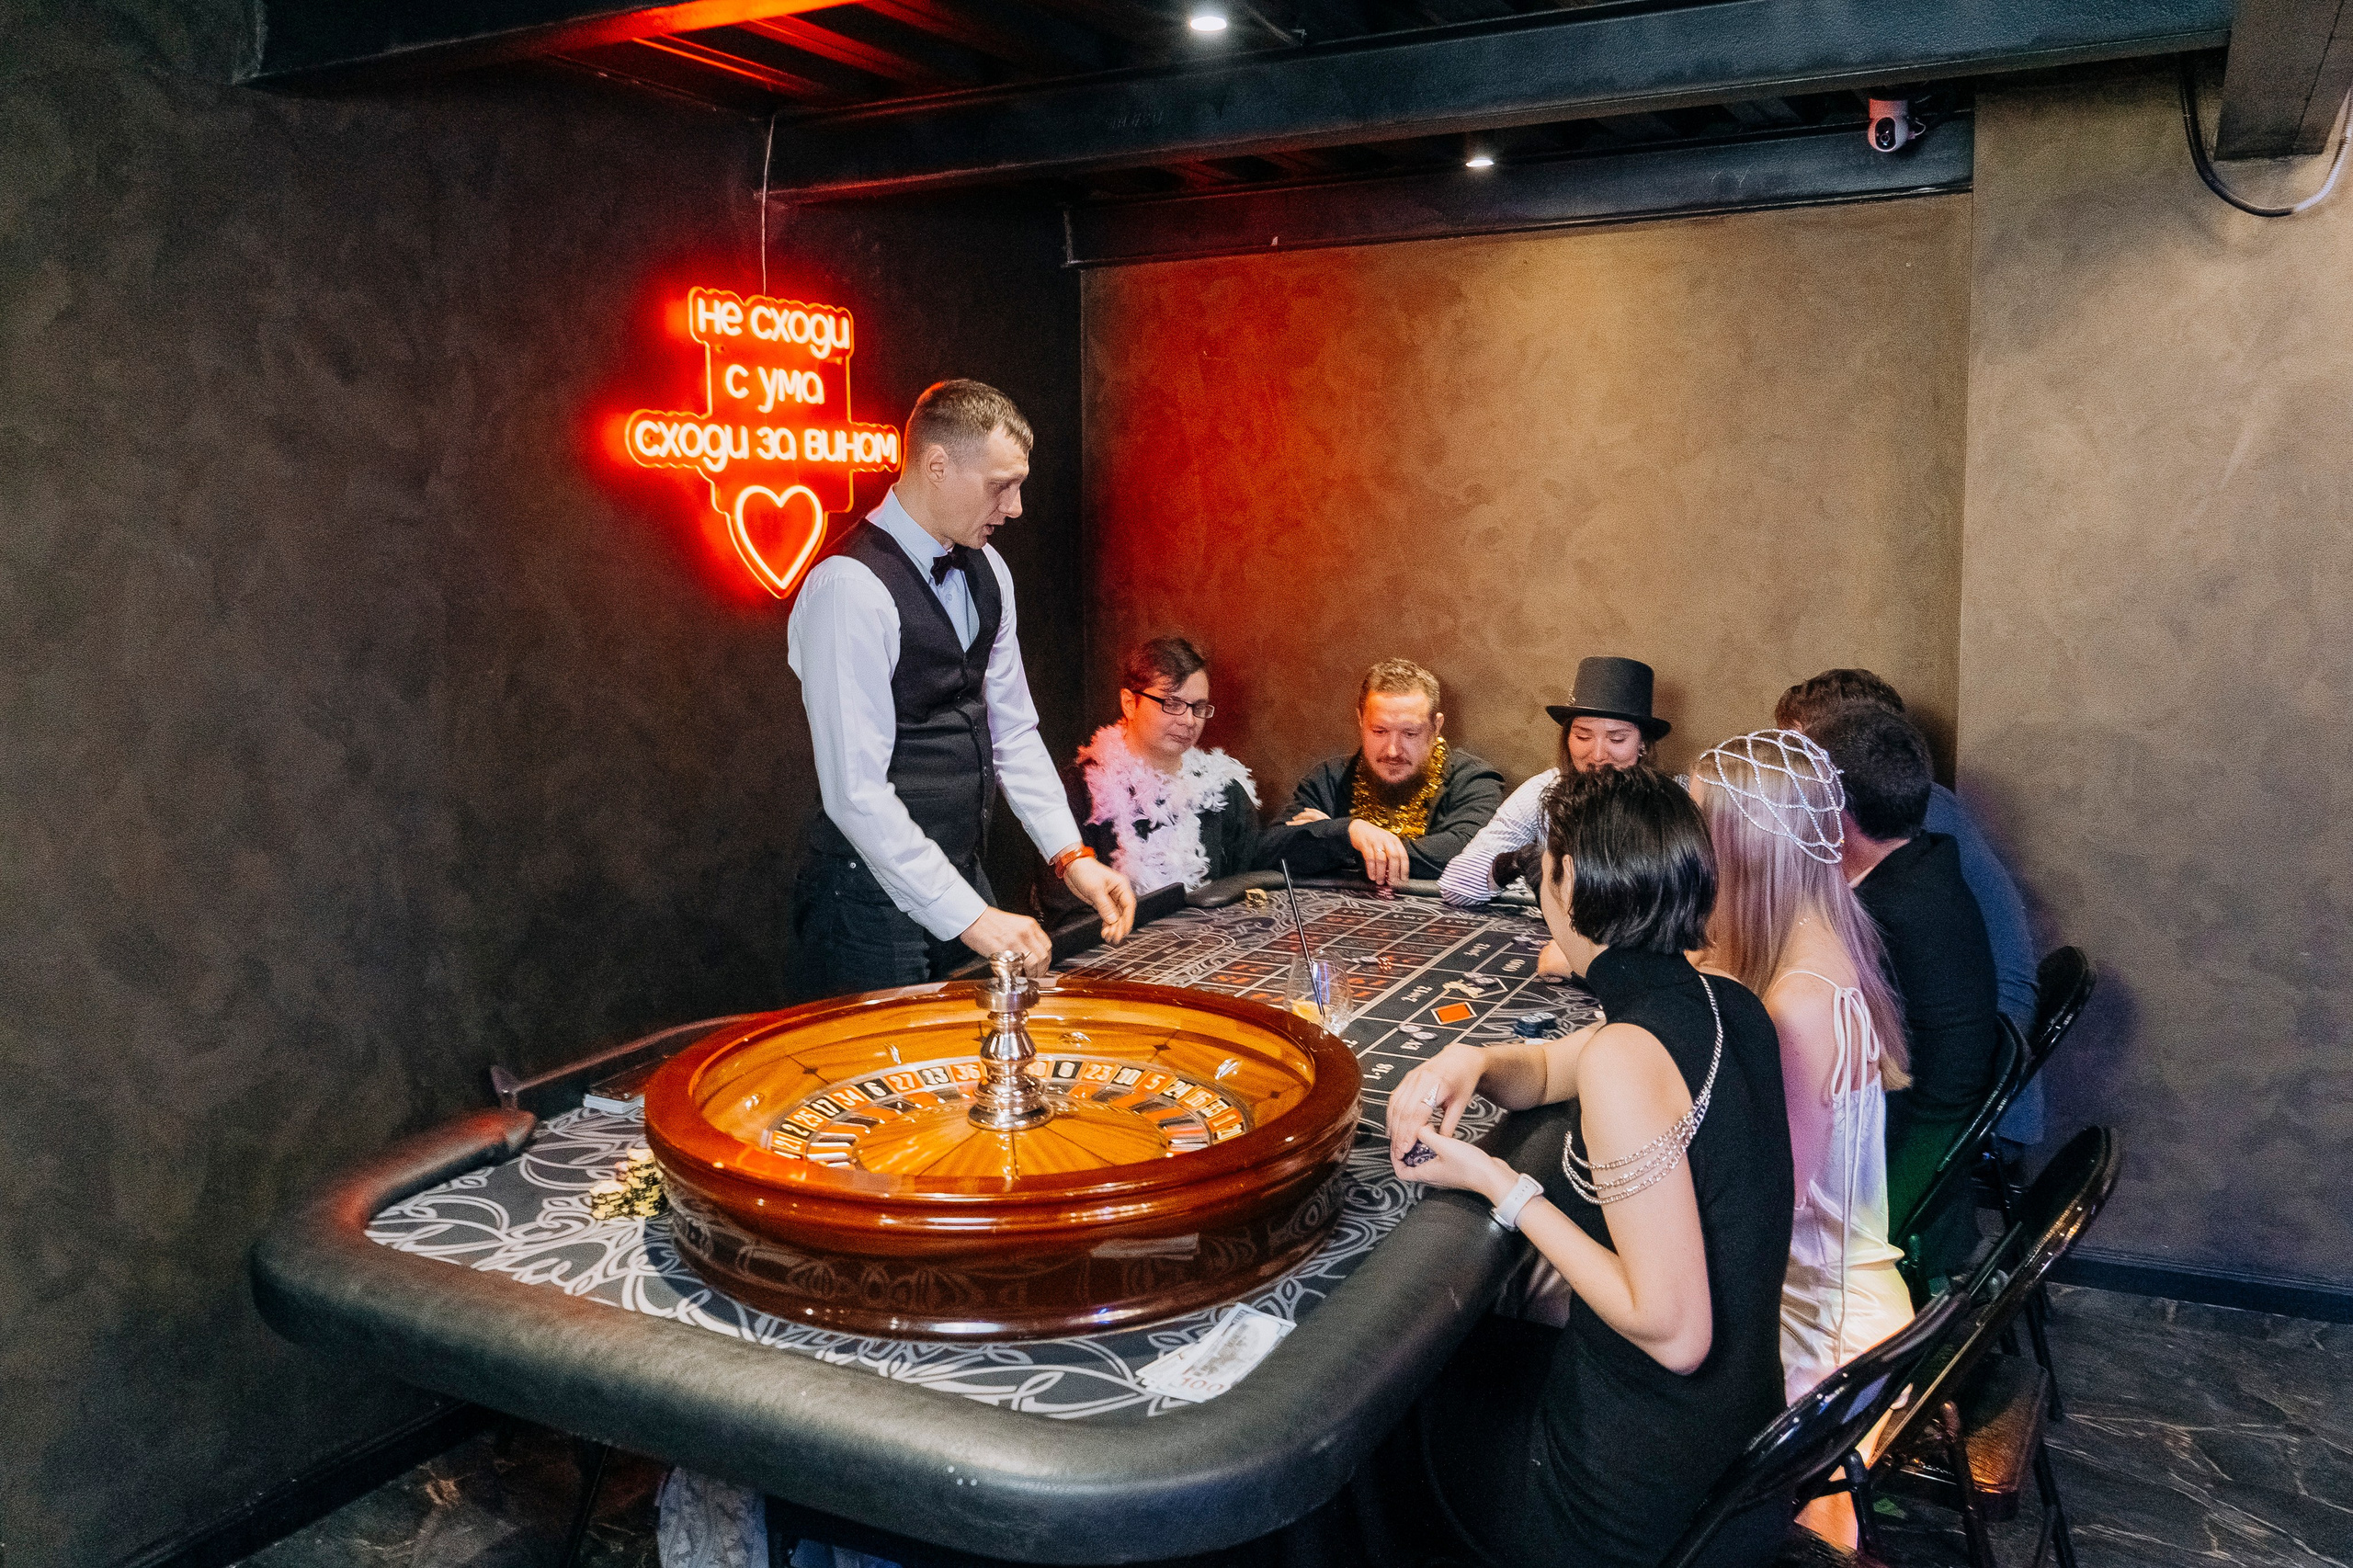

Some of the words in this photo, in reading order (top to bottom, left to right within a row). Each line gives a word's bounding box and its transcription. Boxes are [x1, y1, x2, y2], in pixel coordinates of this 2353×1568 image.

[749, 304, 851, 359] сходи
[723, 363, 750, 399] с
[756, 365, 825, 414] ума
[633, 419, 750, 472] сходи
[756, 426, 798, 460] за
[803, 427, 898, 464] вином
[922, 1067, 951, 1085] 13
[953, 1063, 981, 1081] 36
[1083, 1063, 1113, 1082] 23
[1113, 1067, 1142, 1085] 10
[863, 1081, 887, 1096] 6
[889, 1073, 915, 1090] 27
[1143, 1074, 1166, 1090] 5
[1162, 1080, 1195, 1099] 24
[833, 1089, 866, 1107] 34
[811, 1098, 840, 1117] 17
[793, 1109, 824, 1128] 25
[1212, 1113, 1237, 1128] 1
[781, 1123, 810, 1137] 2
[774, 1135, 803, 1152] 21
